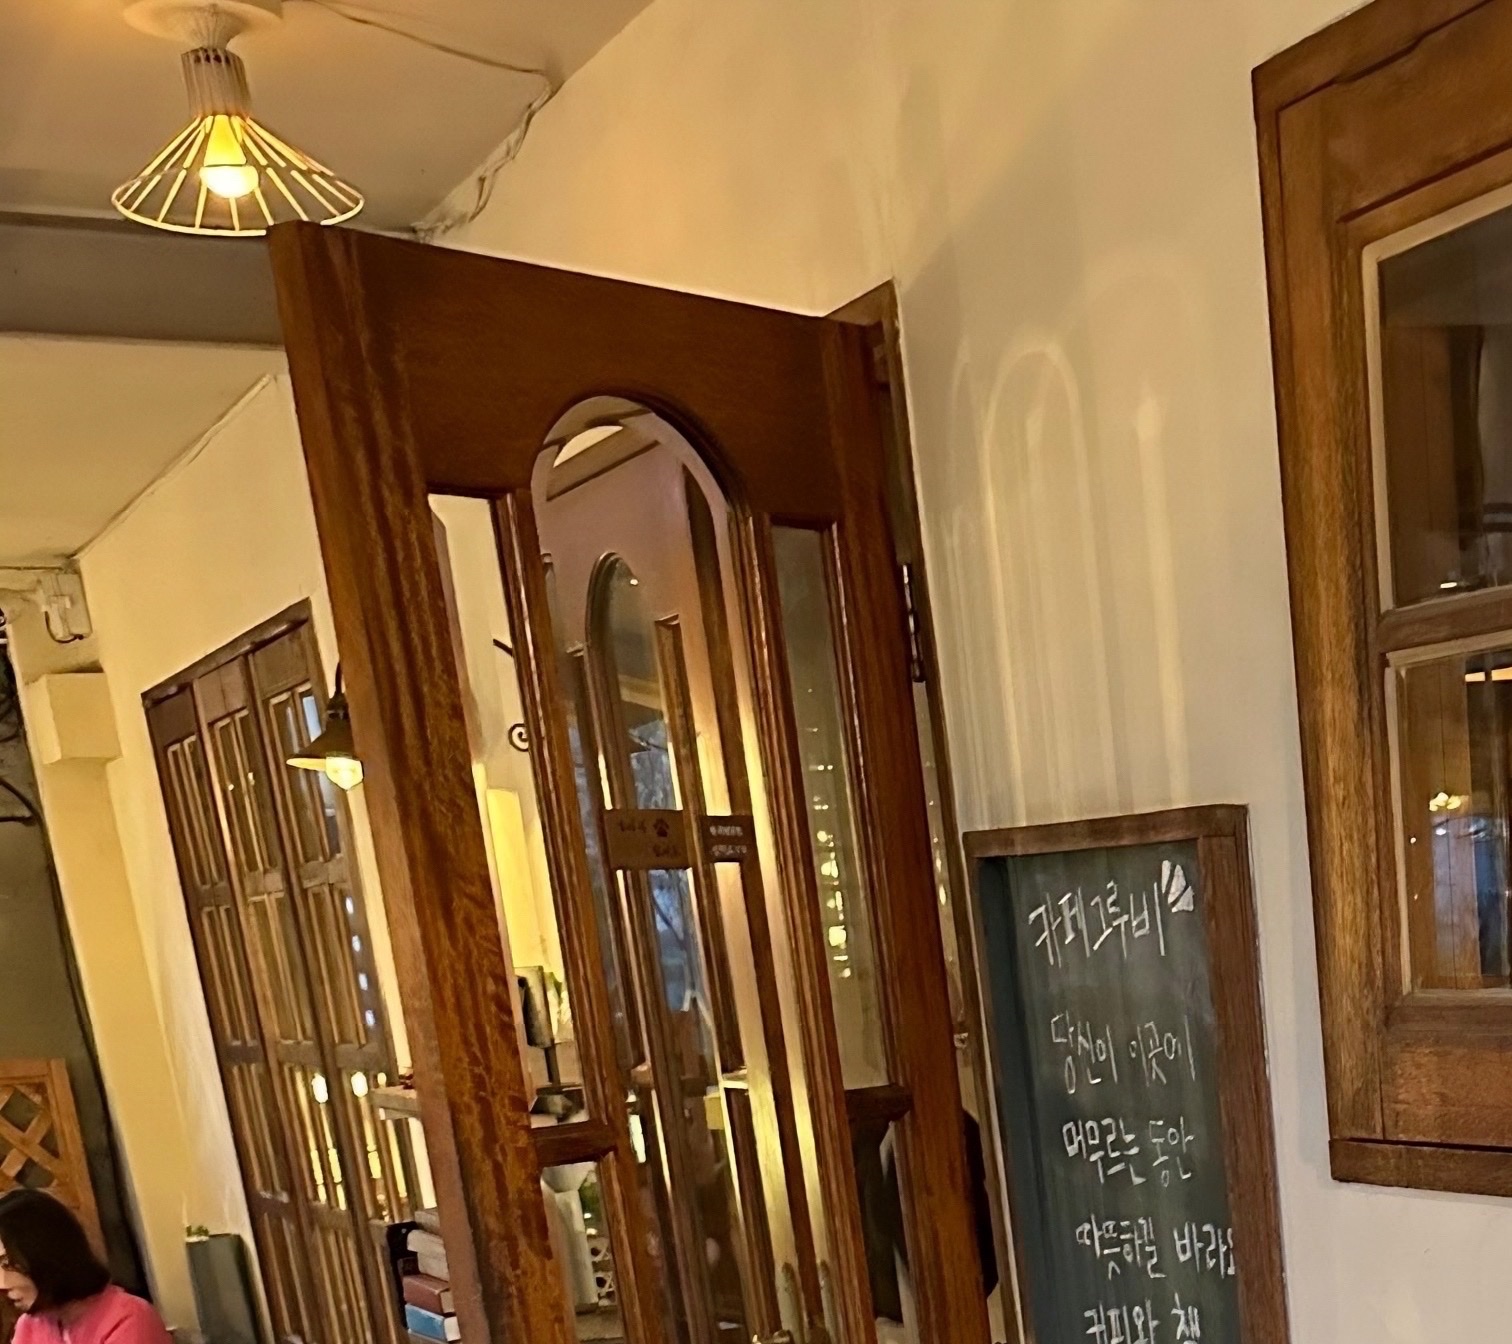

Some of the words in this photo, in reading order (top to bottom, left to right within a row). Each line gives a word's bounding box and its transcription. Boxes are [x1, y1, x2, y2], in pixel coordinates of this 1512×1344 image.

[1028, 879, 1165, 968] 카페그루비
[1050, 1009, 1118, 1094] 당신이
[1061, 1116, 1147, 1185] 머무르는
[1149, 1115, 1194, 1187] 동안
